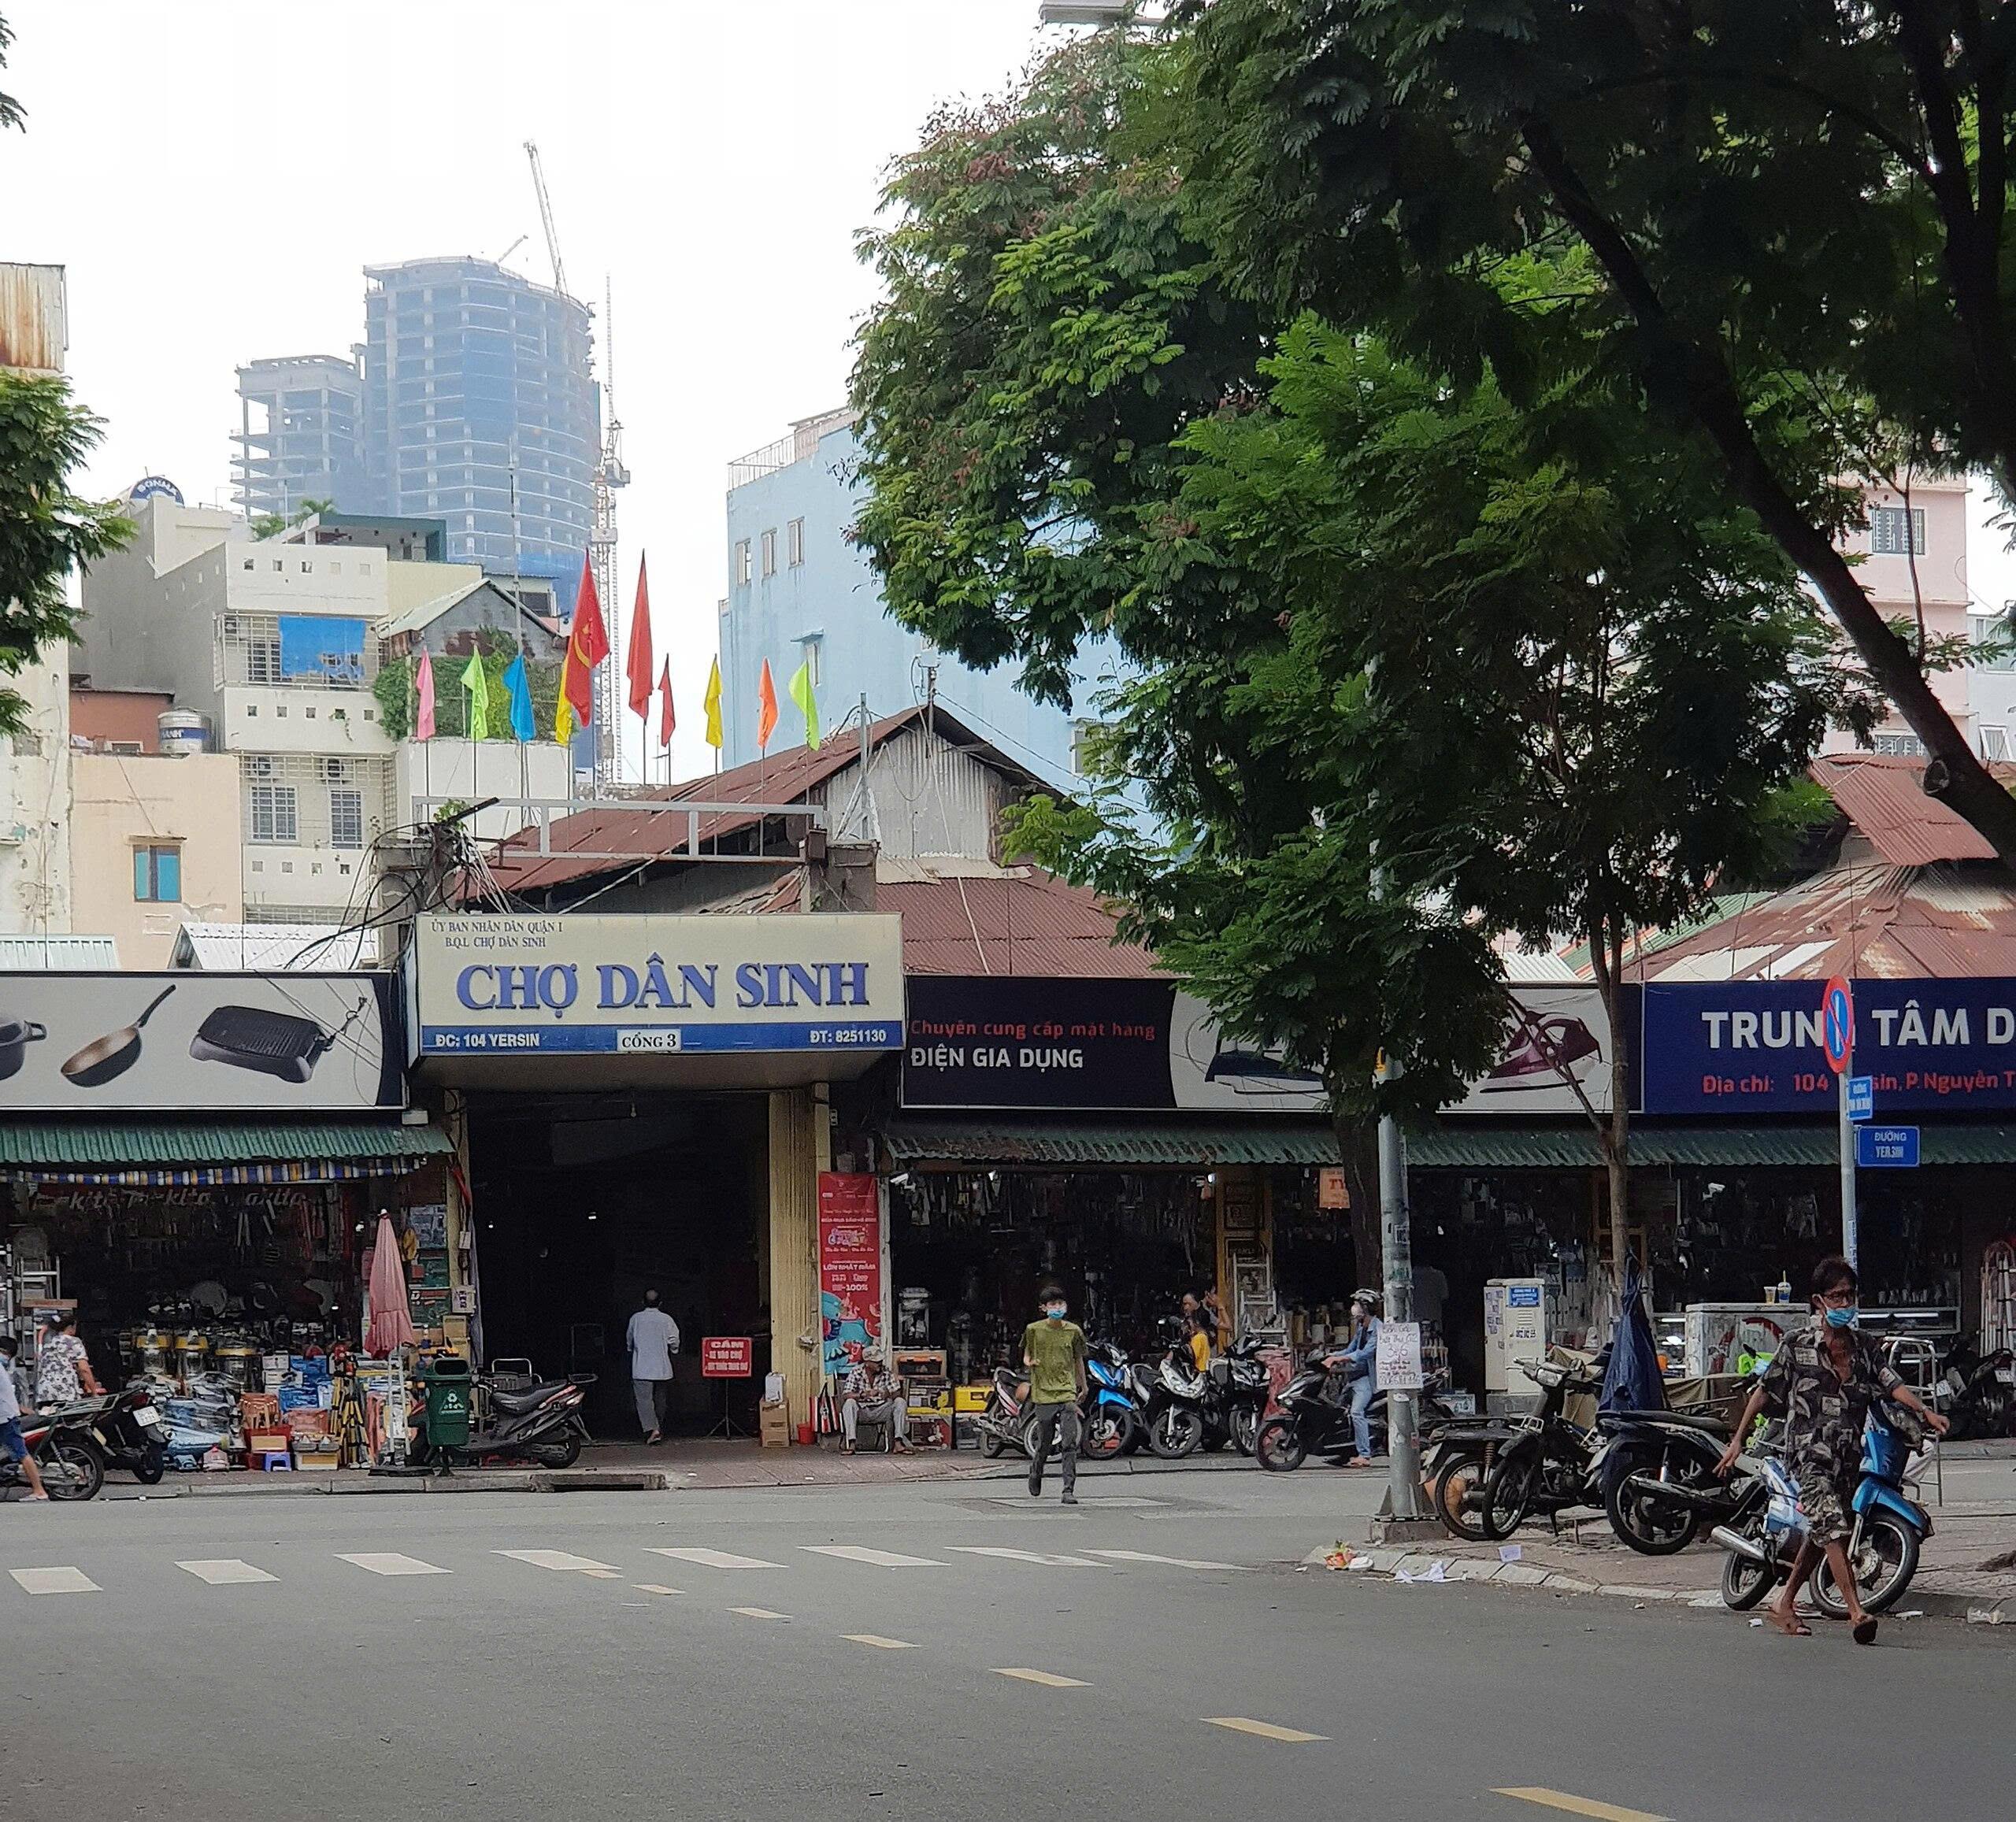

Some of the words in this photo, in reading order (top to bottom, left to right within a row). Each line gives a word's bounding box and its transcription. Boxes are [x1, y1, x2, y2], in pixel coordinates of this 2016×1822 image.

[449, 921, 469, 932] BAN
[472, 920, 501, 932] NHÂN
[504, 920, 524, 932] DÂN
[528, 919, 554, 935] QUẬN
[473, 935, 495, 950] CHỢ
[498, 937, 519, 947] DÂN
[522, 937, 547, 947] SINH
[456, 961, 578, 1019] CHỢ
[596, 951, 719, 1009] DÂN
[736, 961, 870, 1009] SINH
[911, 1020, 976, 1038] Chuyên
[984, 1024, 1027, 1040] cung
[1702, 1010, 1855, 1049] TRUN
[1871, 999, 1970, 1046] TÂM
[464, 1033, 486, 1047] 104
[488, 1032, 540, 1047] YERSIN
[622, 1031, 663, 1048] CỔNG
[667, 1034, 676, 1047] 3
[836, 1029, 887, 1043] 8251130
[910, 1042, 965, 1072] ĐIỆN
[973, 1047, 1011, 1067] GIA
[1020, 1048, 1083, 1072] DỤNG
[1793, 1072, 1829, 1093] 104
